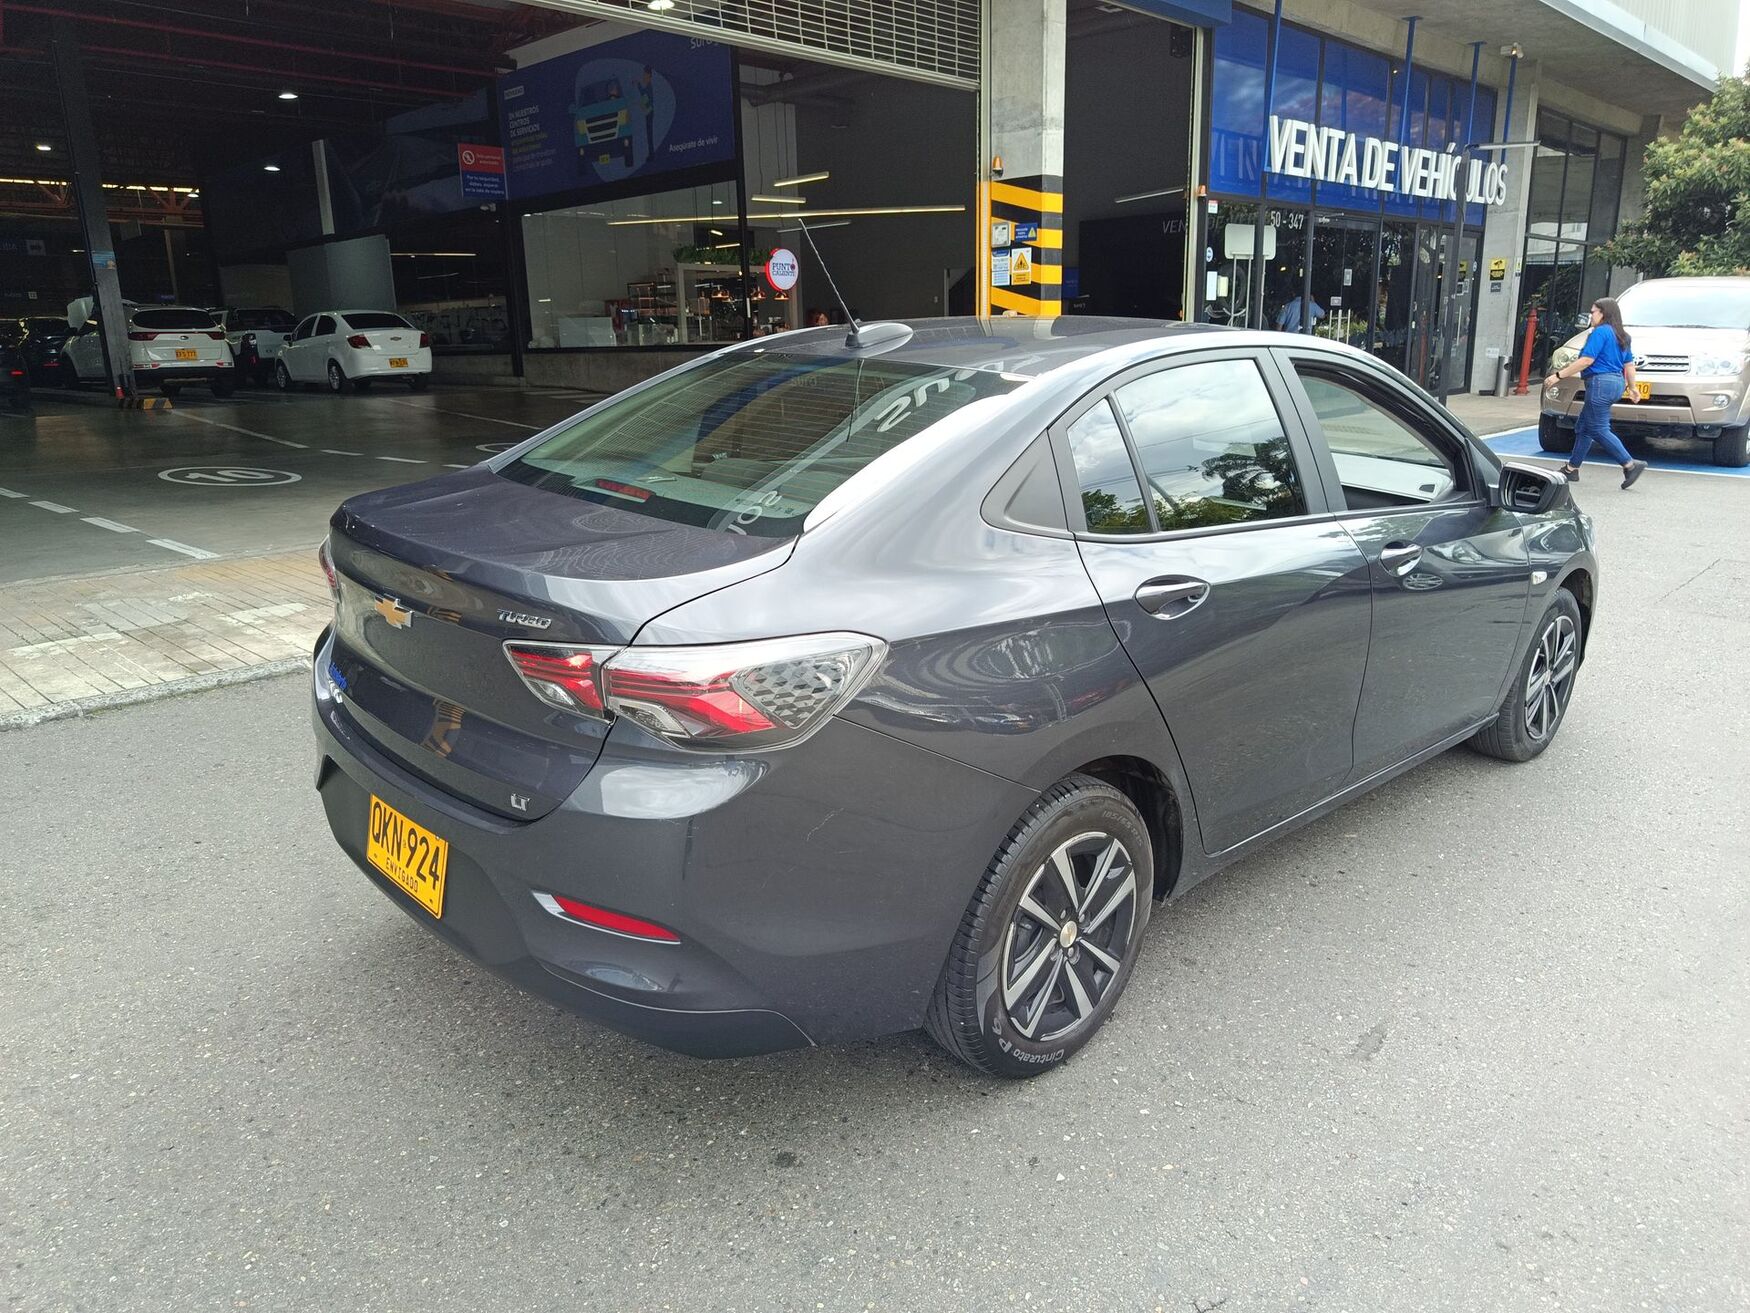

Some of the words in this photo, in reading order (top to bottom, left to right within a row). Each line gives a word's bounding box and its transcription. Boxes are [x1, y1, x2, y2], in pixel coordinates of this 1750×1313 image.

[1270, 115, 1358, 186] VENTA
[1361, 137, 1398, 192] DE
[1270, 210, 1281, 228] 50
[1288, 212, 1304, 230] 347
[497, 608, 553, 629] TURBO
[511, 793, 531, 812] LT
[385, 857, 419, 893] ENVIGADO
